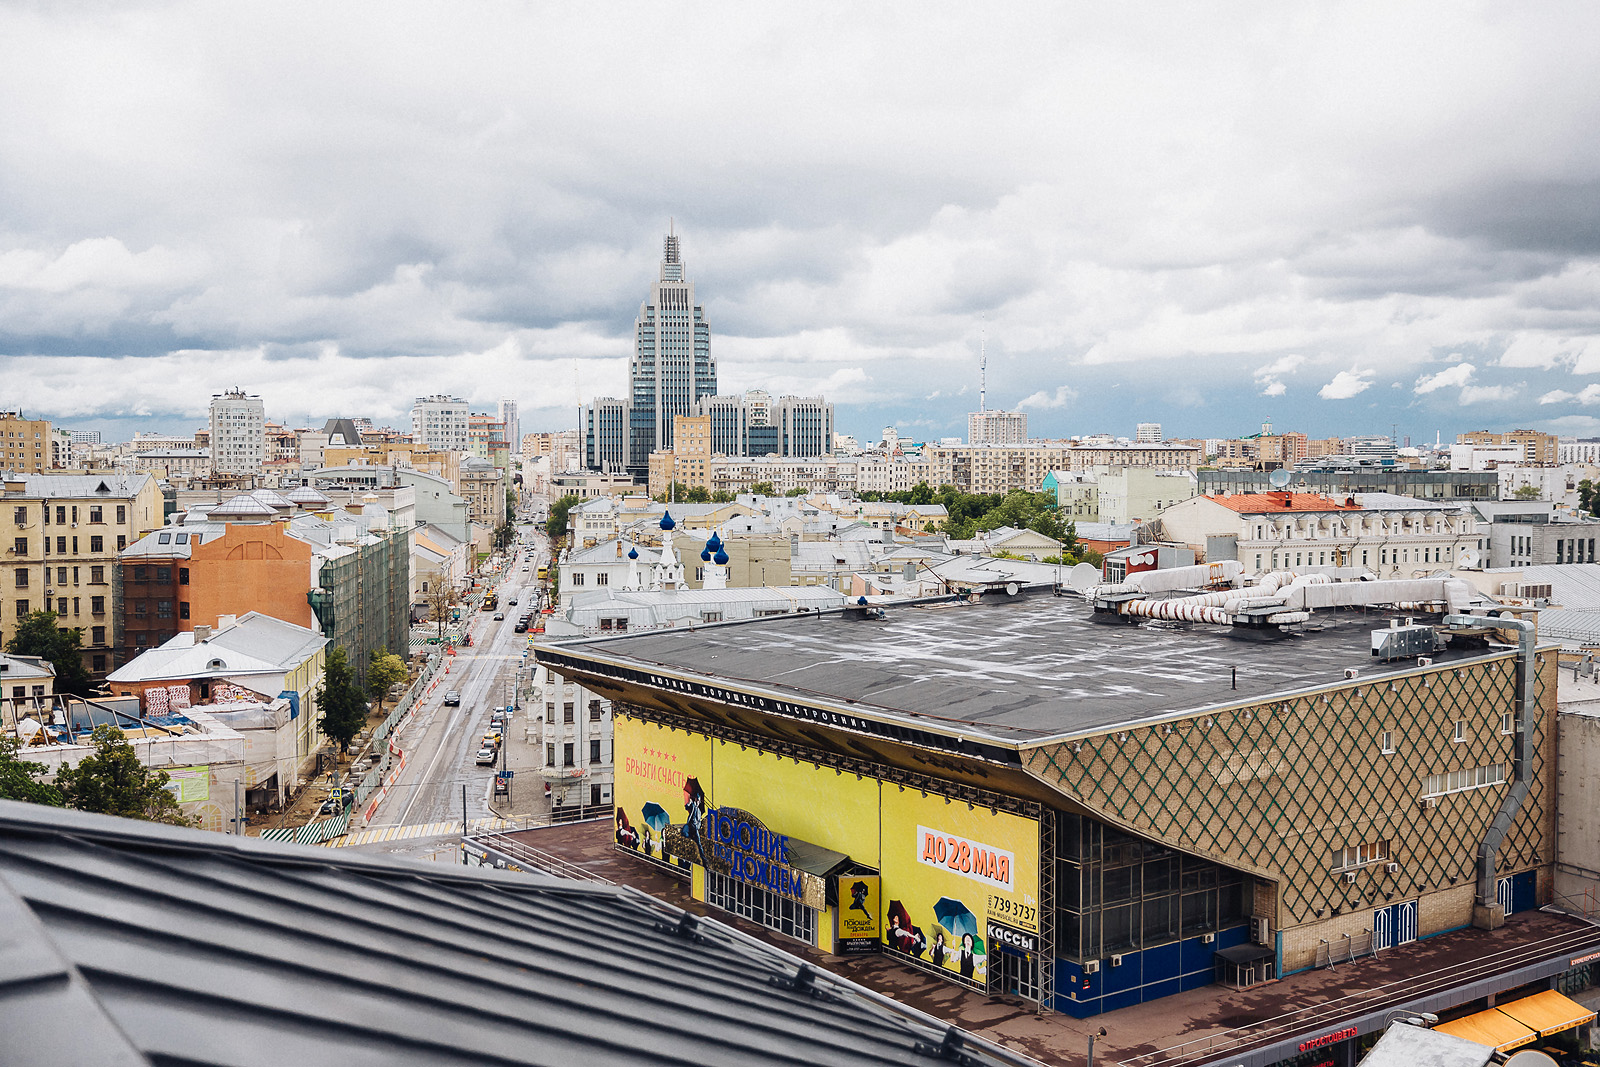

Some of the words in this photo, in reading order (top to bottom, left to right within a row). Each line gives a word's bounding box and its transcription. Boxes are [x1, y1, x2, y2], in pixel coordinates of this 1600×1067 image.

[650, 675, 692, 691] МЮЗИКЛ
[701, 686, 765, 707] ХОРОШЕГО
[776, 702, 867, 728] НАСТРОЕНИЯ
[625, 757, 657, 780] БРЫЗГИ
[657, 766, 695, 789] СЧАСТЬ
[707, 807, 789, 865] ПОЮЩИЕ
[714, 843, 732, 864] ПОД
[731, 850, 802, 899] ДОЖДЕМ
[923, 833, 947, 864] ДО
[947, 837, 971, 874] 28
[972, 847, 1010, 884] МАЯ
[993, 895, 1011, 913] 739
[1012, 902, 1036, 922] 3737
[1023, 893, 1036, 905] 10+
[1305, 1026, 1358, 1050] ПРОСТОЦВЕТЫ
